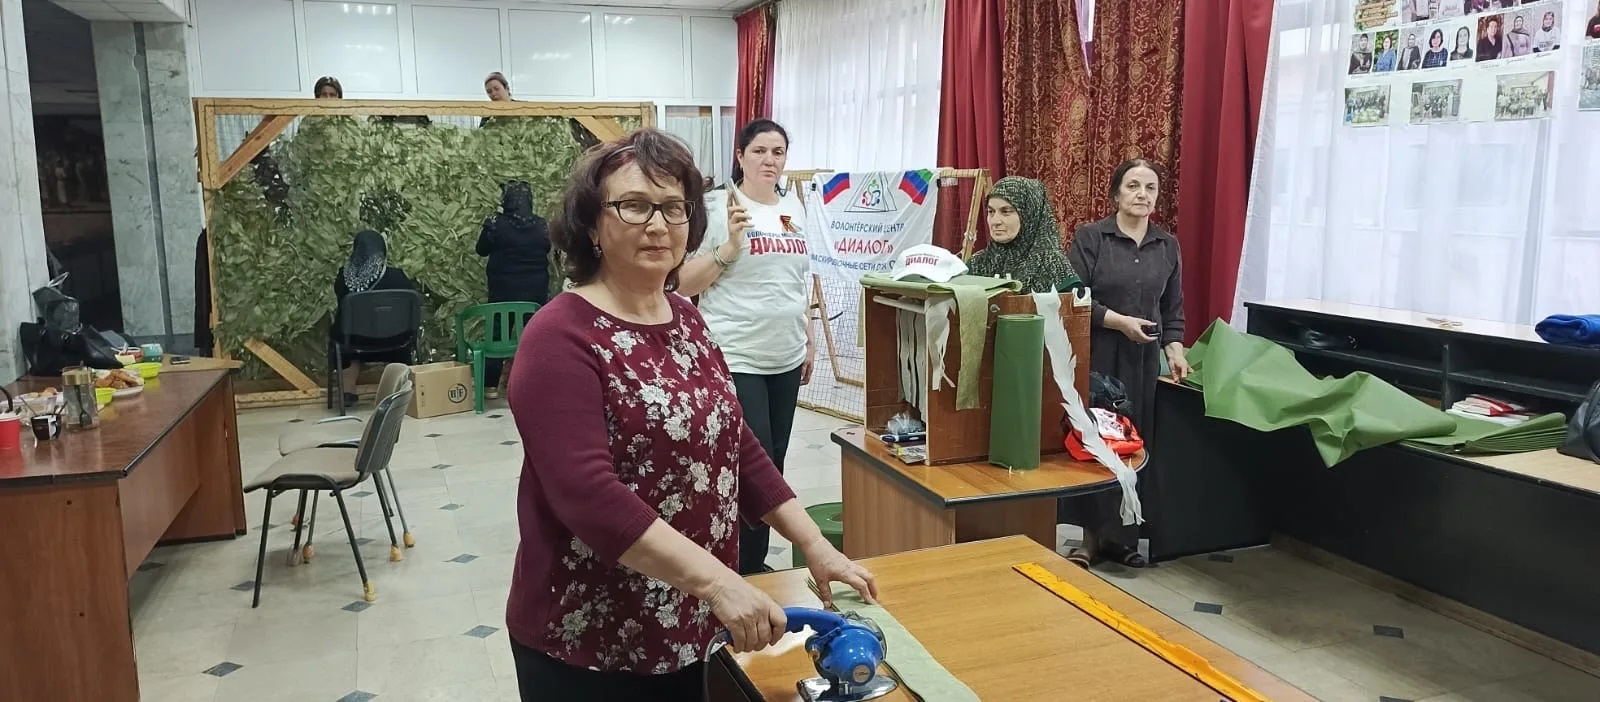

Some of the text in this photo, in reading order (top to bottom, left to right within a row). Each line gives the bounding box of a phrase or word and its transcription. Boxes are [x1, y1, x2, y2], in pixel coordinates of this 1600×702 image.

[750, 236, 808, 256] ДИАЛОГ
[834, 237, 894, 255] «ДИАЛОГ»
[905, 255, 939, 268] ДИАЛОГ
